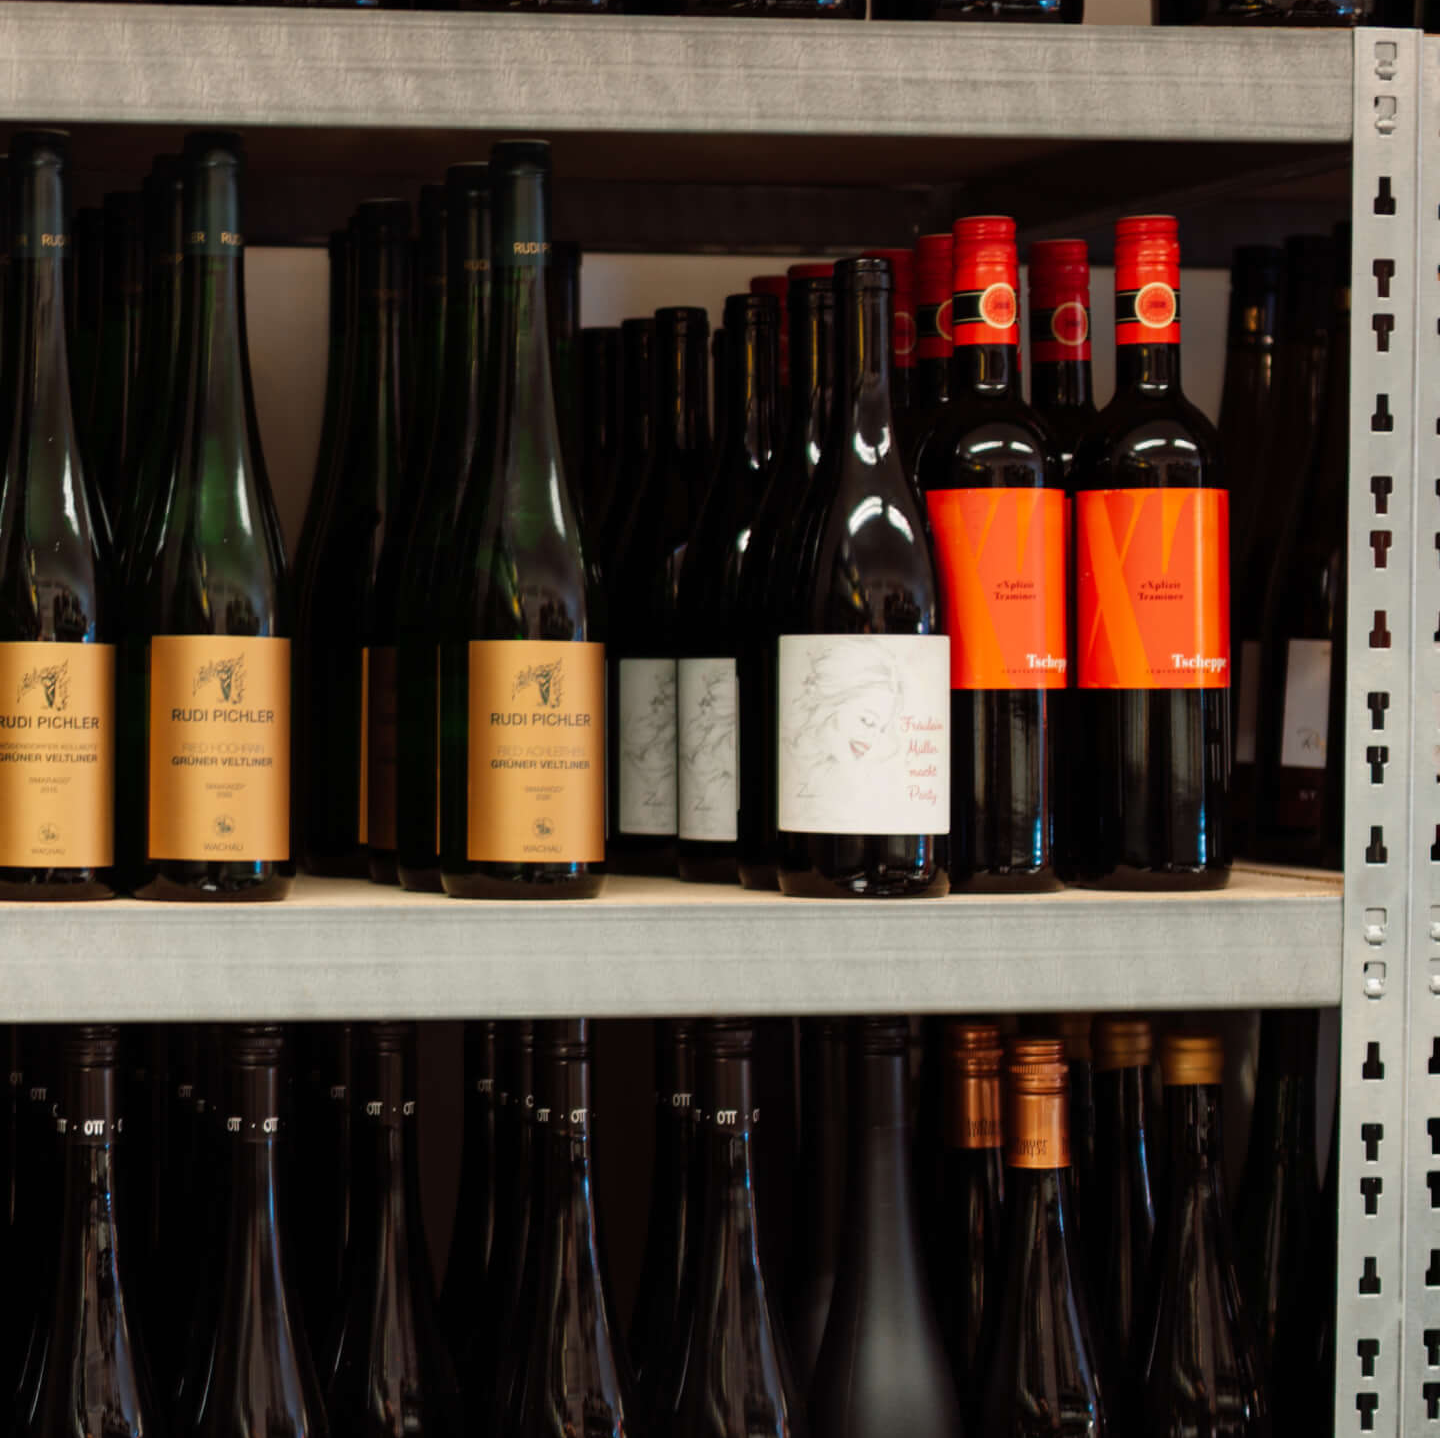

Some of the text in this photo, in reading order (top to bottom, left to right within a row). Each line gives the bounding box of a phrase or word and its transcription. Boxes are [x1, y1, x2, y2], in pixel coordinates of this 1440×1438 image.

[1171, 653, 1227, 673] Tscheppe
[37, 716, 100, 729] PICHLER
[171, 708, 275, 723] RUDI PICHLER
[490, 712, 591, 727] RUDI PICHLER
[45, 752, 98, 763] VELTLINER
[171, 755, 273, 767] GRÜNER VELTLINER
[490, 759, 590, 770] GRÜNER VELTLINER
[716, 1109, 737, 1126] OTT
[84, 1118, 105, 1136] OTT
